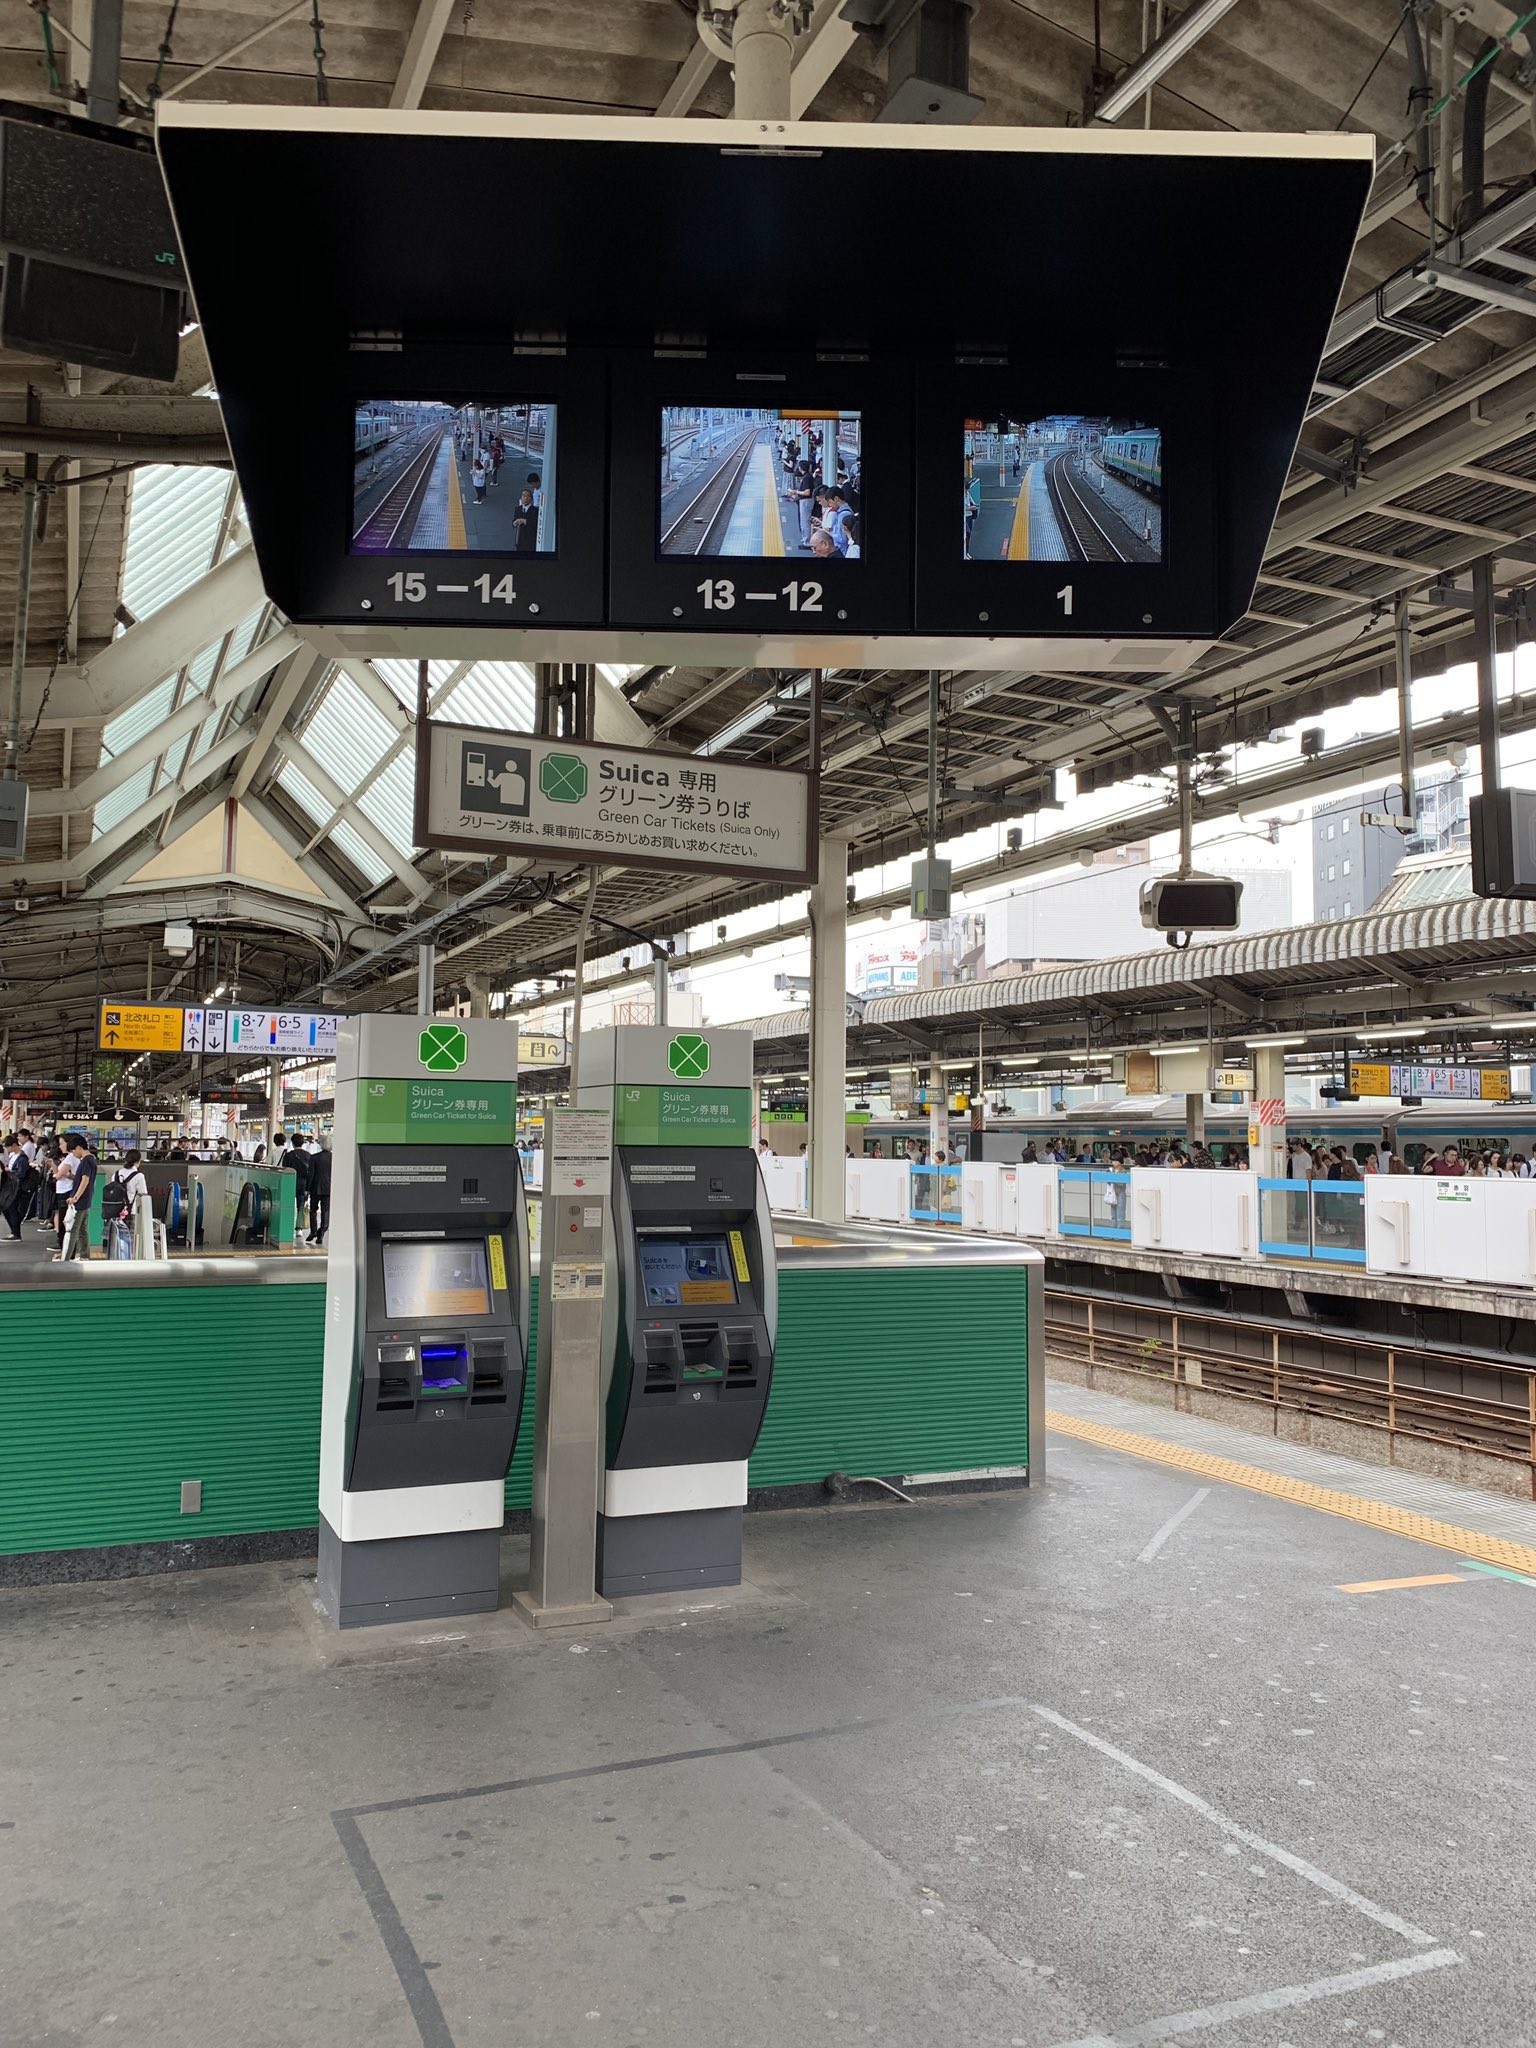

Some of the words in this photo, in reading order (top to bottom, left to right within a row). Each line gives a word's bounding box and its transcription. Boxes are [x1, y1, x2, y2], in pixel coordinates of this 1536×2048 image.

[155, 252, 175, 265] JR
[1056, 585, 1073, 615] 1
[599, 759, 670, 787] Suica
[678, 769, 717, 793] 専用
[599, 785, 751, 819] グリーン券うりば
[598, 808, 640, 825] Green
[643, 813, 668, 828] Car
[671, 817, 716, 833] Tickets
[720, 822, 751, 835] (Suica
[754, 826, 781, 840] Only)
[458, 814, 758, 858] グリーン券は、乗車前にあらかじめお買い求めください。
[124, 1012, 161, 1023] 北改札口
[411, 1085, 444, 1097] Suica
[662, 1091, 691, 1102] Suica
[914, 1090, 921, 1100] 2
[411, 1098, 488, 1111] グリーン券専用
[662, 1104, 729, 1115] グリーン券専用
[410, 1111, 432, 1119] Green
